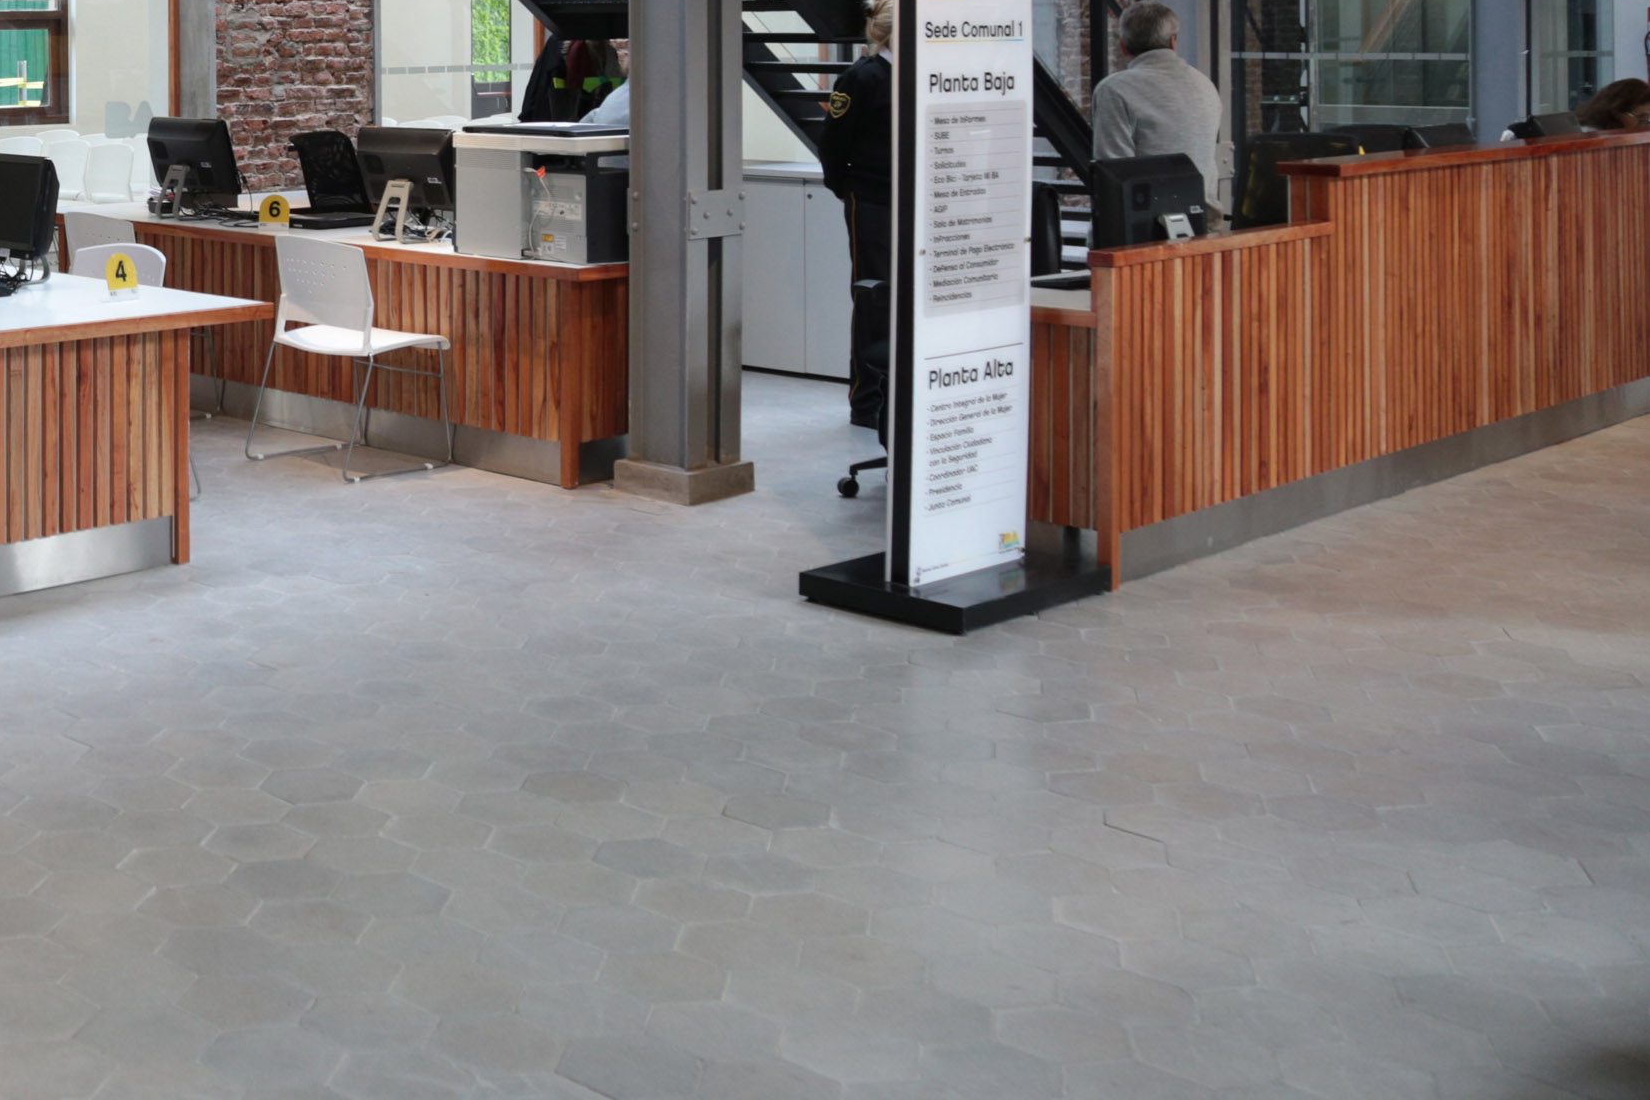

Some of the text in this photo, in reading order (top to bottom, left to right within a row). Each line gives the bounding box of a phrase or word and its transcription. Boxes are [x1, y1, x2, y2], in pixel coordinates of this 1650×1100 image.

[925, 20, 1023, 39] Sede Comunal 1
[929, 71, 1015, 96] Planta Baja
[934, 131, 949, 140] SUBE
[950, 189, 958, 197] de
[269, 201, 280, 217] 6
[116, 260, 127, 282] 4
[928, 358, 1014, 390] Planta Alta
